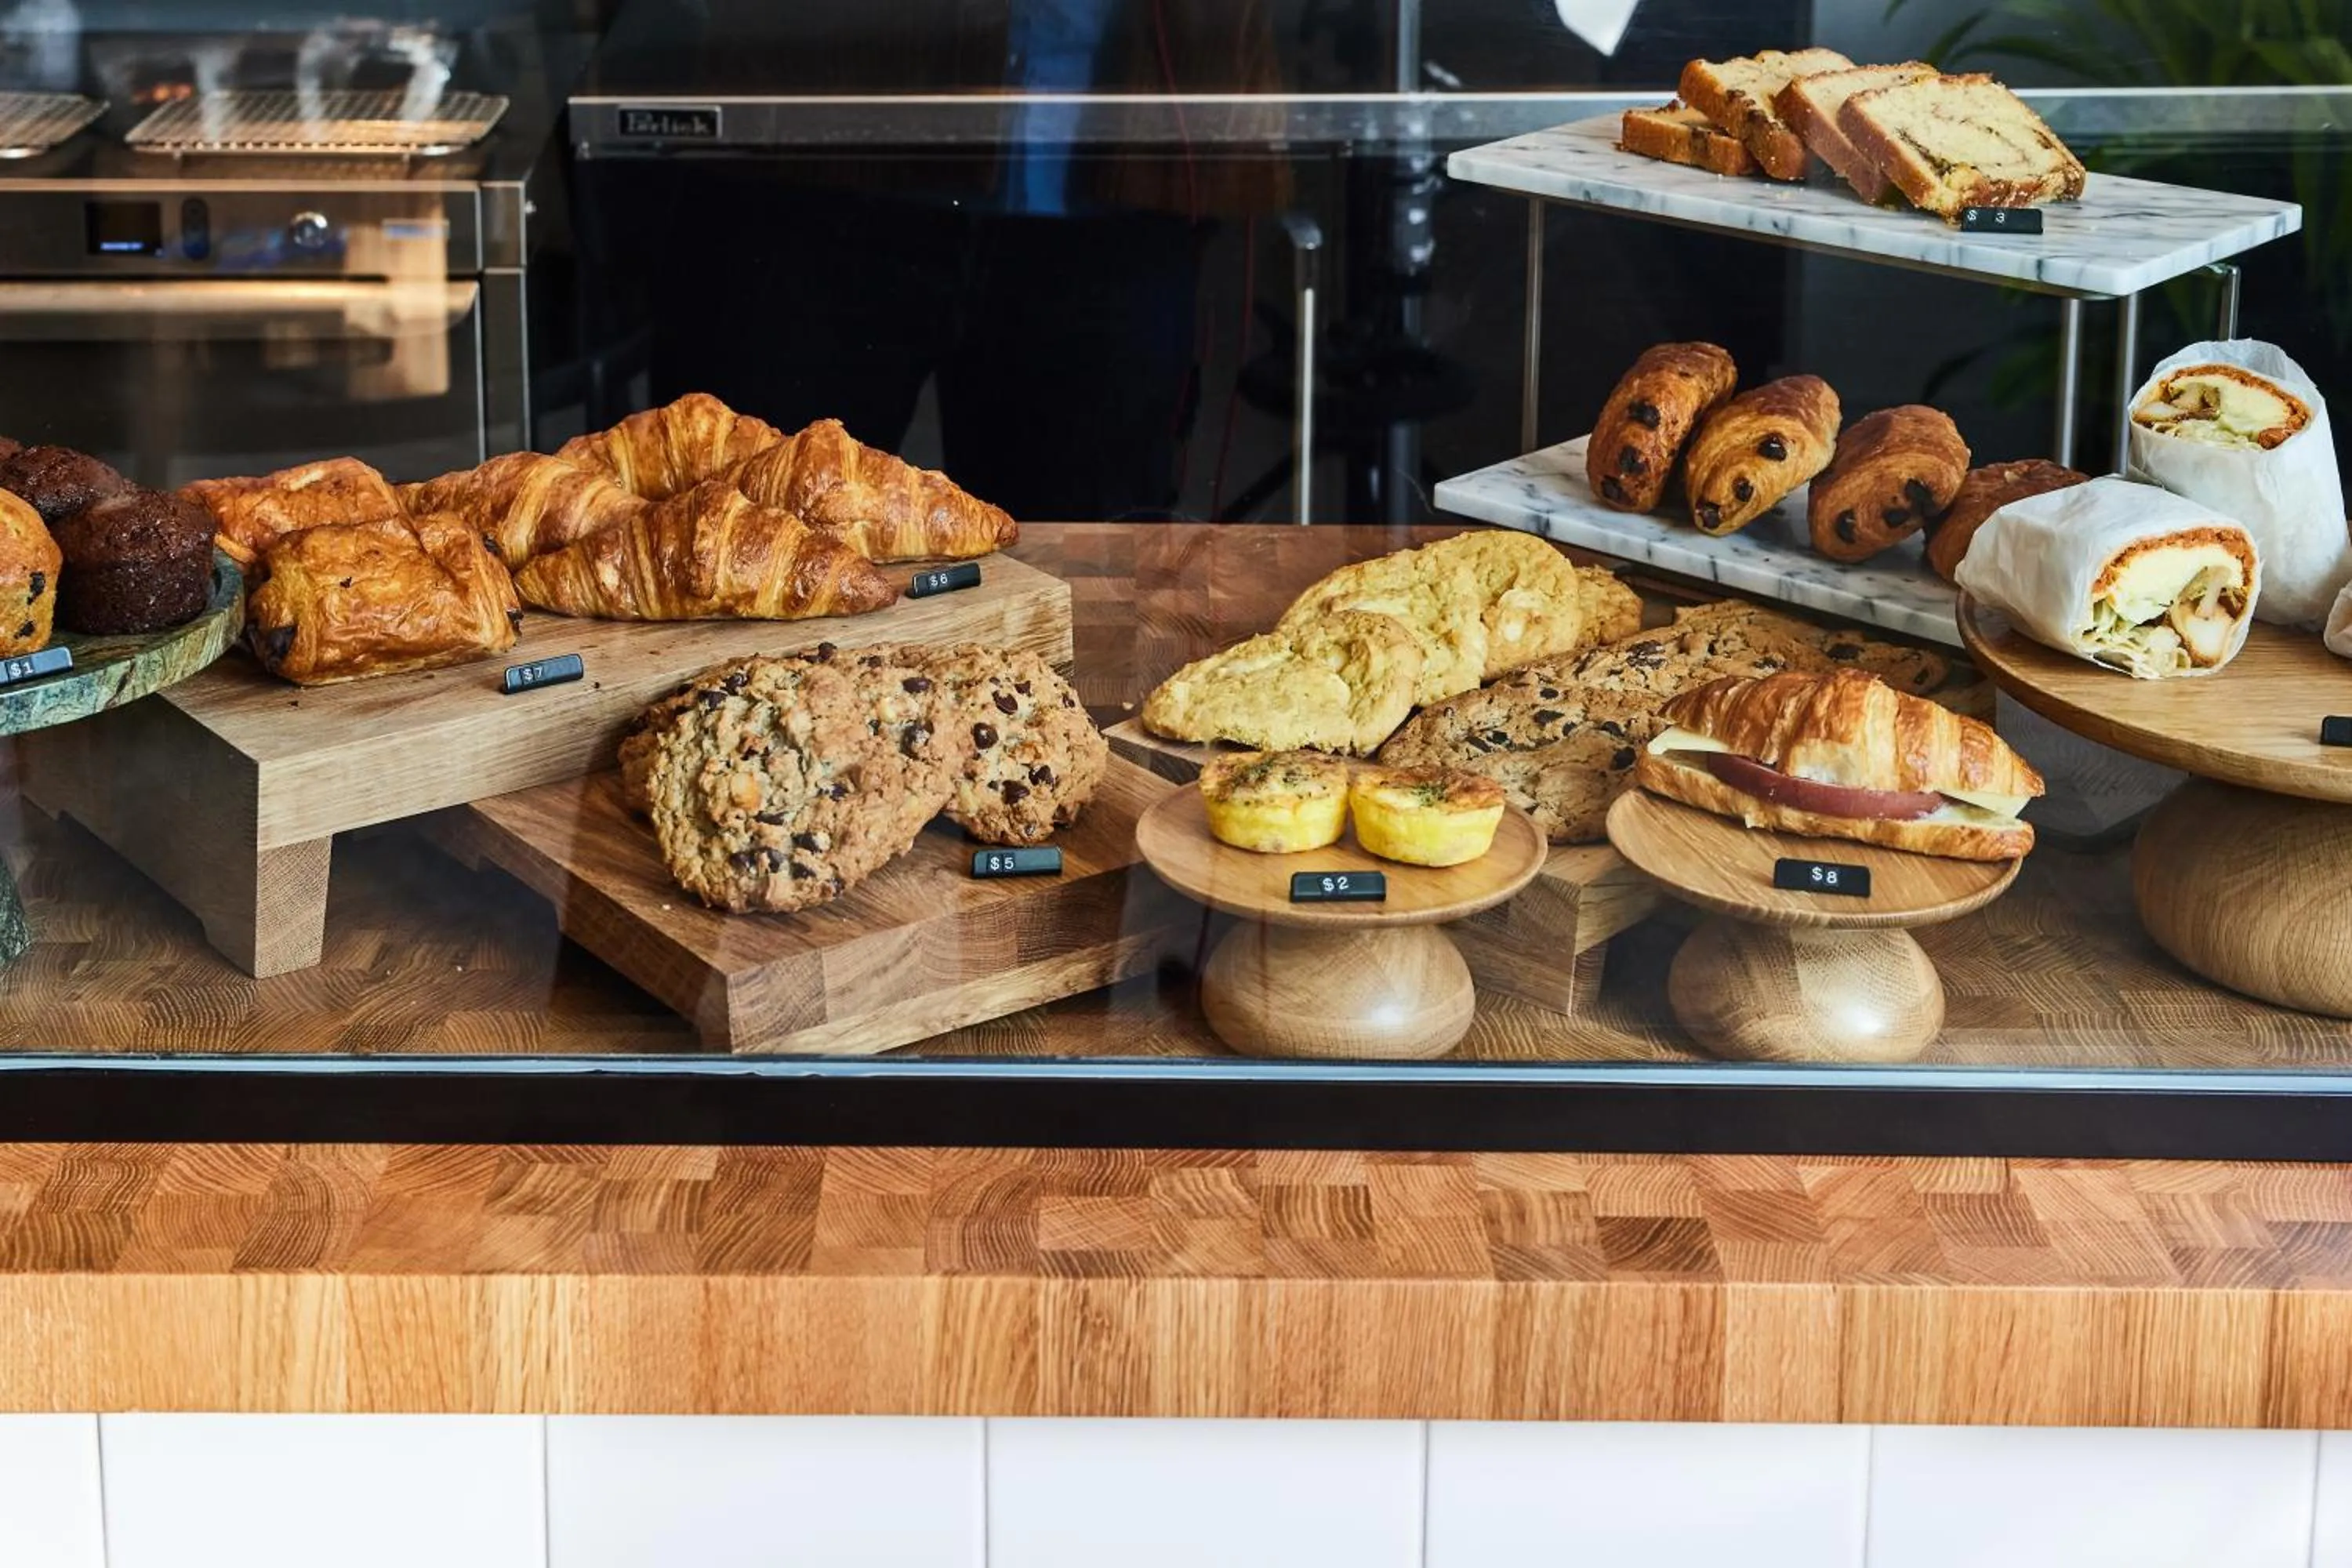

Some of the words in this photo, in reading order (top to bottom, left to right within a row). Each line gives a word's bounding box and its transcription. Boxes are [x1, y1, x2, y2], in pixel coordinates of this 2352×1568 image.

[929, 573, 948, 587] $6
[10, 662, 33, 677] $1
[523, 666, 543, 681] $7
[990, 856, 1014, 870] $5
[1812, 866, 1837, 884] $8
[1323, 876, 1348, 891] $2
